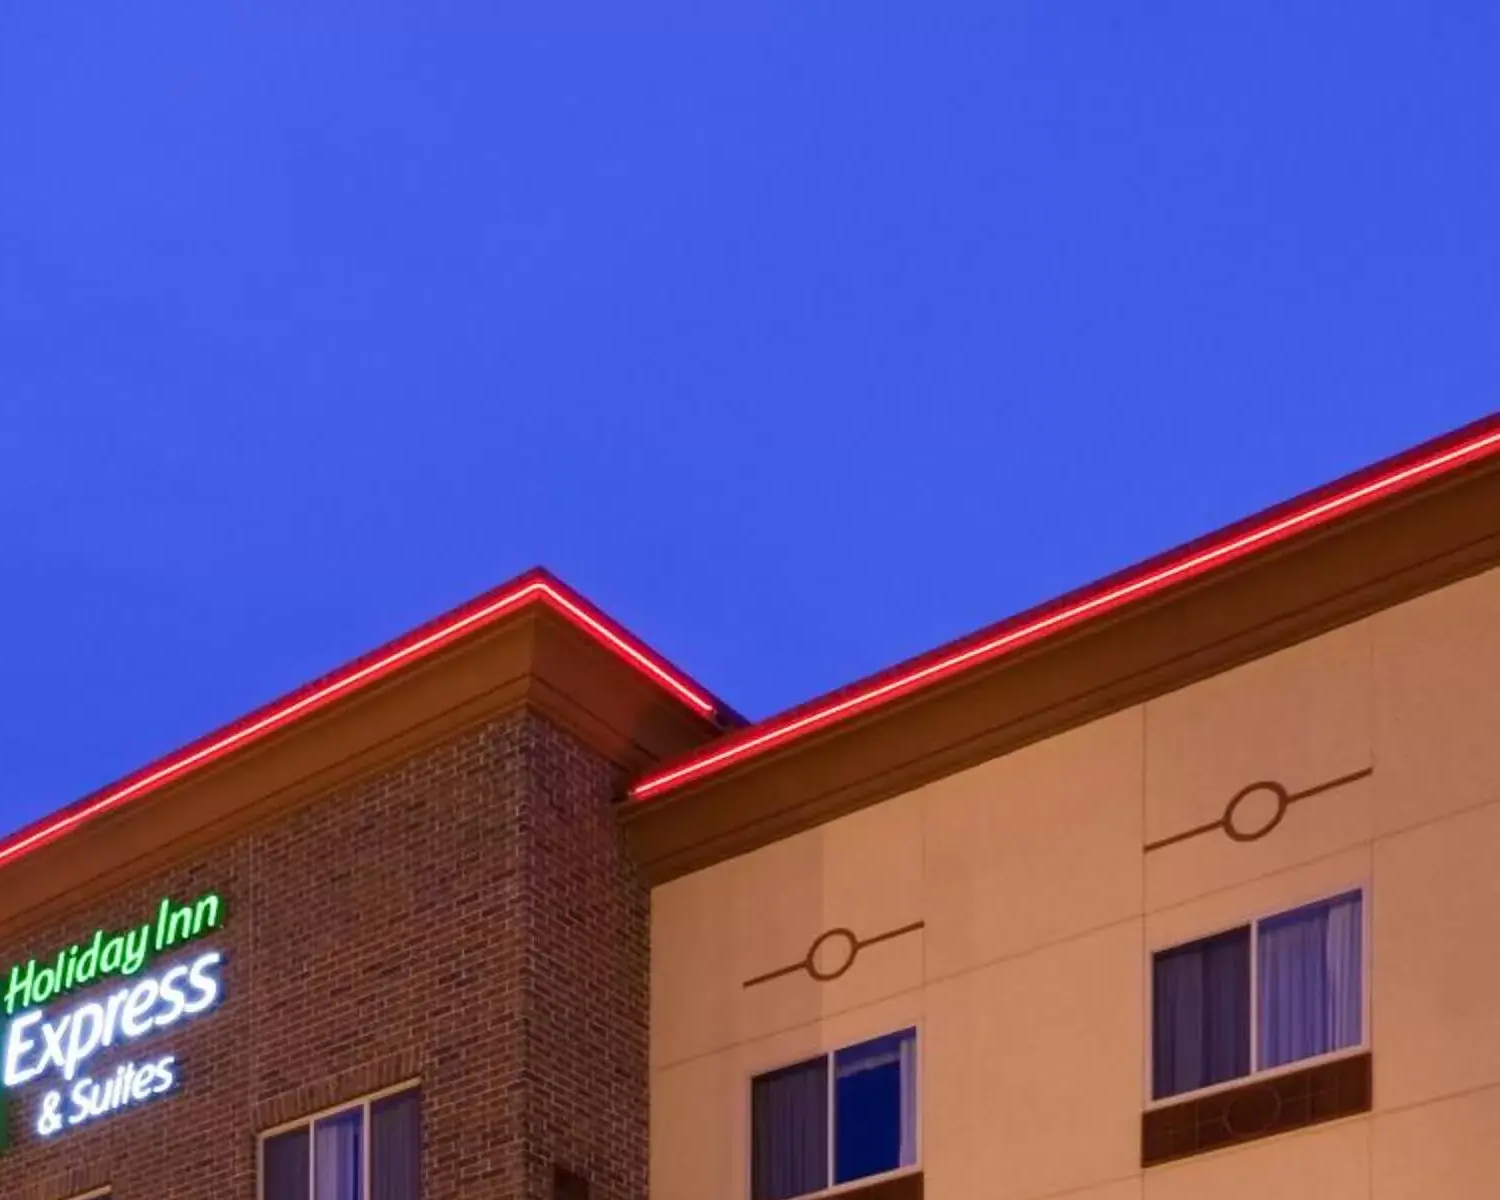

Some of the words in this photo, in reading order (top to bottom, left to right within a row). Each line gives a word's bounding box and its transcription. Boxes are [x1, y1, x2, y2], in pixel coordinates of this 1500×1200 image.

[4, 924, 150, 1013] Holiday
[155, 894, 220, 951] Inn
[3, 952, 222, 1088] Express
[37, 1090, 63, 1136] &
[69, 1055, 176, 1125] Suites
